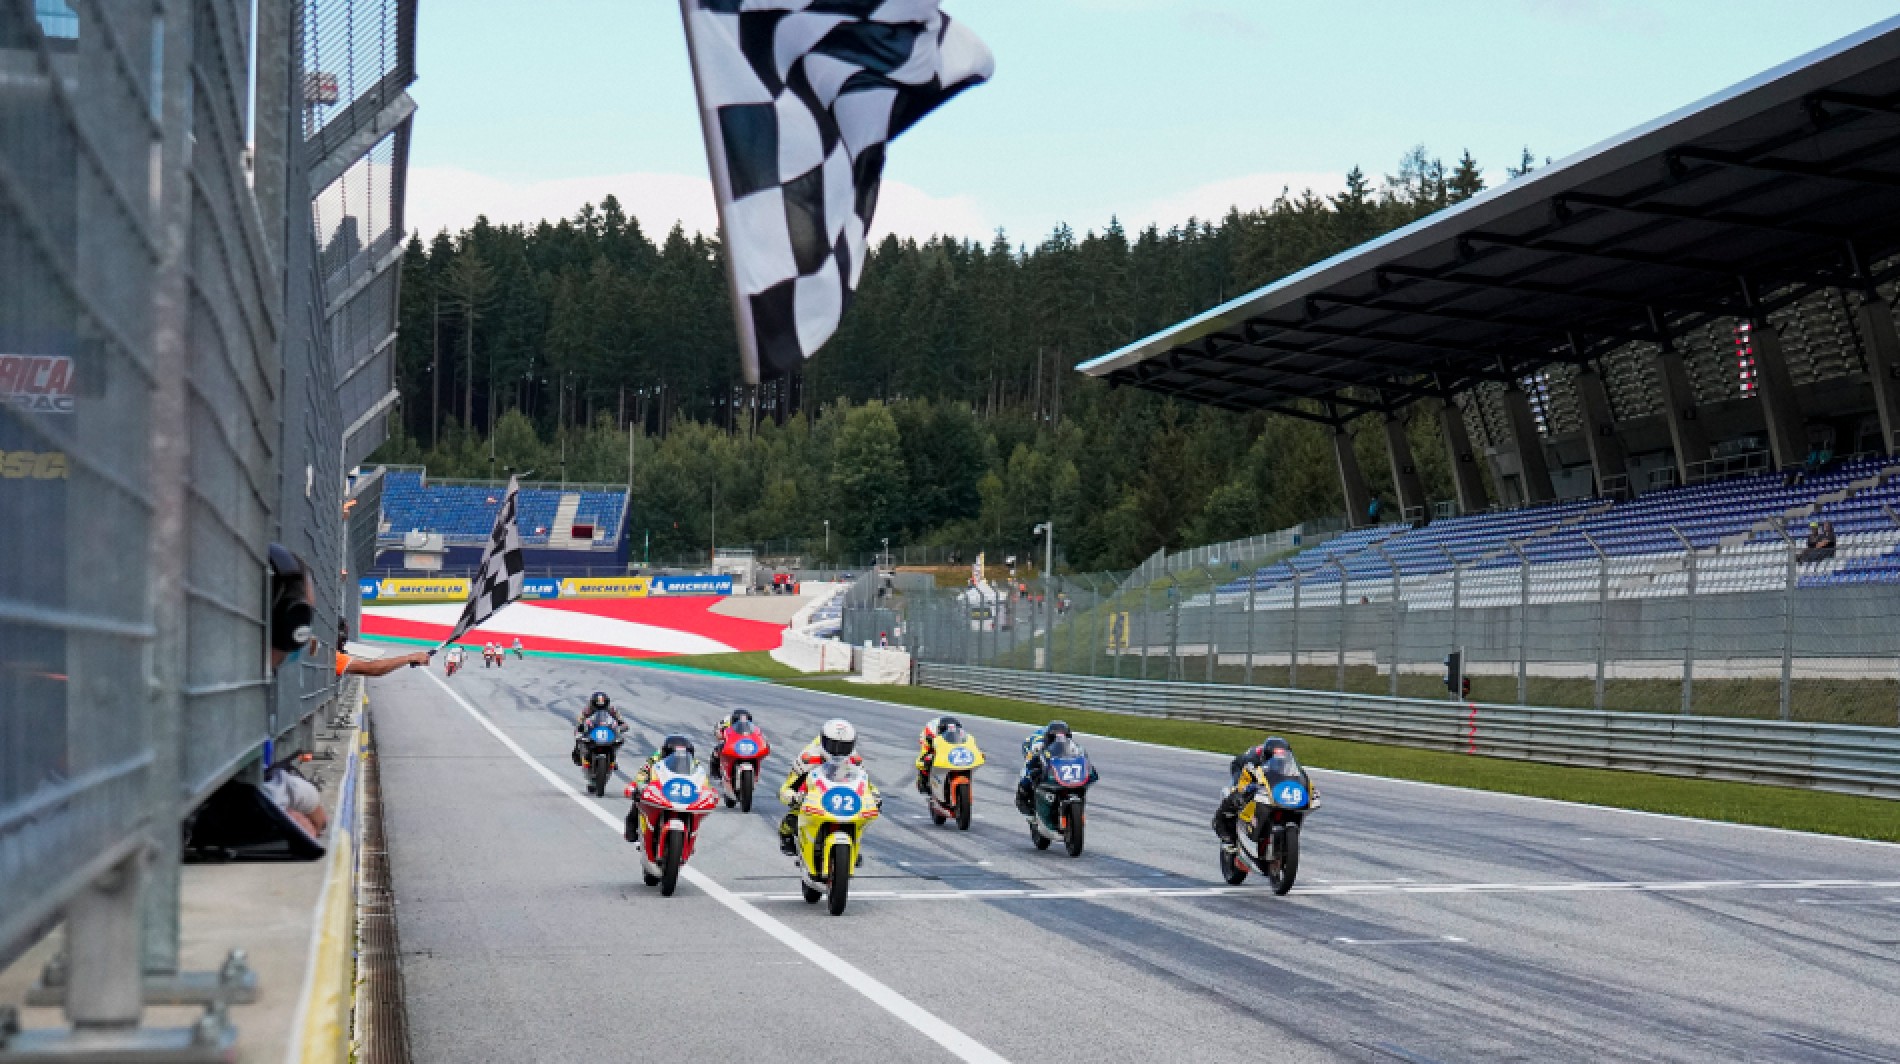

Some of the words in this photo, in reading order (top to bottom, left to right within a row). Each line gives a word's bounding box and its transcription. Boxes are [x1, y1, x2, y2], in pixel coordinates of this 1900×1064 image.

[0, 356, 71, 393] RICA
[399, 585, 463, 593] MICHELIN
[523, 584, 554, 593] ELIN
[580, 585, 643, 593] MICHELIN
[668, 581, 731, 591] MICHELIN
[1061, 763, 1082, 781] 27
[669, 782, 691, 797] 28
[831, 794, 855, 811] 92
